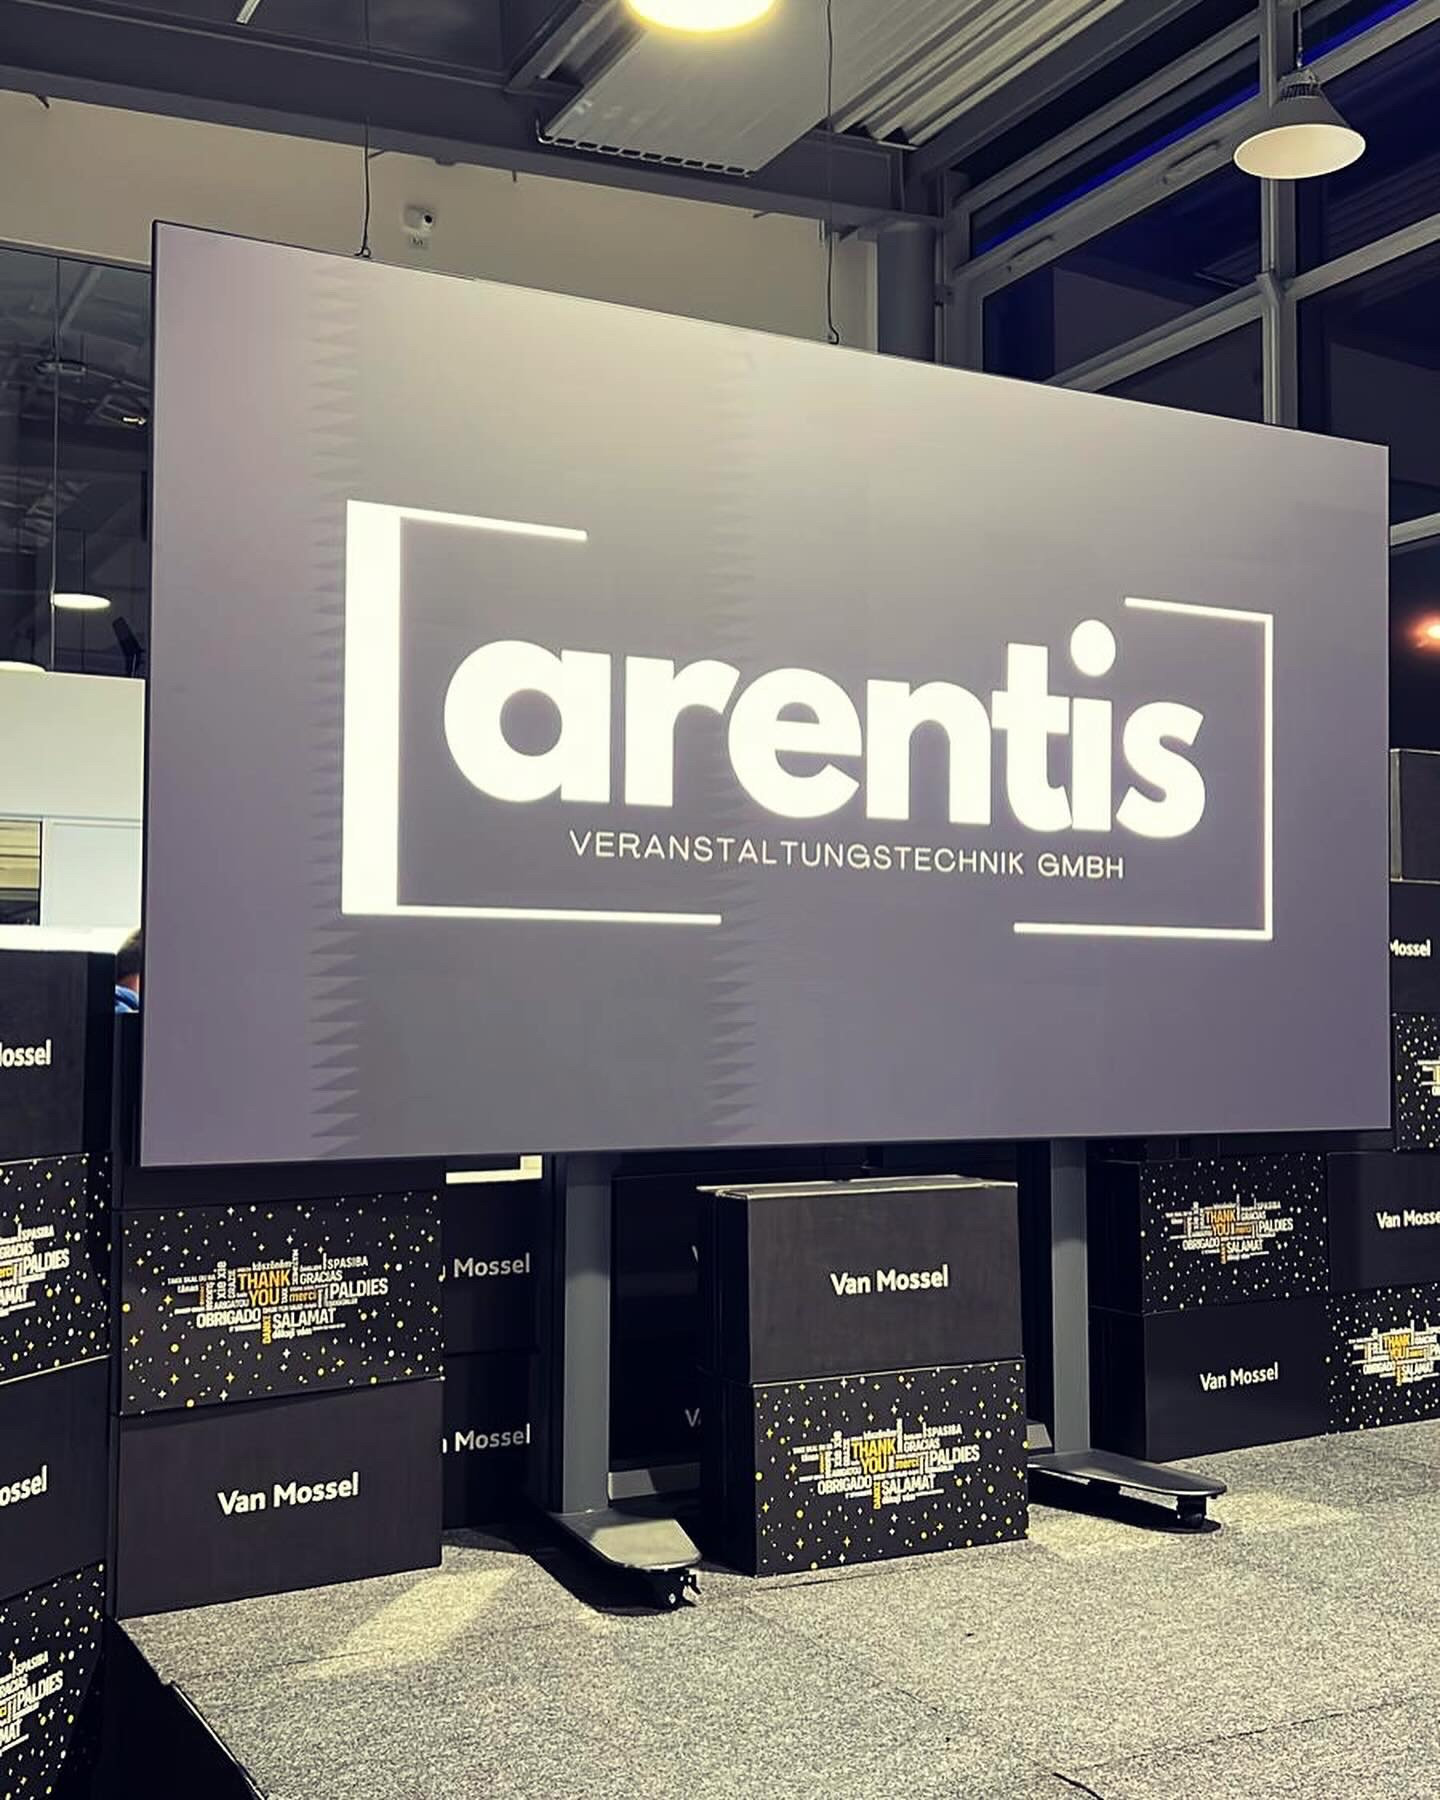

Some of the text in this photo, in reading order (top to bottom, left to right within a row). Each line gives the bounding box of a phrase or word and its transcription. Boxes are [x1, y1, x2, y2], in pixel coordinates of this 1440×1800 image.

[445, 618, 1206, 839] arentis
[570, 830, 1123, 880] VERANSTALTUNGSTECHNIK GMBH
[0, 1039, 51, 1067] ossel
[1376, 1211, 1400, 1229] Van
[24, 1248, 70, 1275] PALDIES
[327, 1256, 369, 1270] SPASIBA
[454, 1252, 530, 1278] Mossel
[237, 1269, 291, 1292] THANK
[300, 1270, 343, 1285] GRACIAS
[330, 1277, 389, 1301] PALDIES
[830, 1263, 949, 1296] Van Mossel
[248, 1287, 280, 1308] YOU
[196, 1307, 262, 1329] OBRIGADO
[272, 1308, 337, 1331] SALAMAT
[1200, 1361, 1278, 1391] Van Mossel
[455, 1423, 531, 1453] Mossel
[850, 1438, 896, 1461] THANK
[860, 1455, 888, 1475] YOU
[929, 1445, 980, 1467] PALDIES
[218, 1471, 360, 1515] Van Mossel
[817, 1475, 872, 1496] OBRIGADO
[882, 1474, 936, 1496] SALAMAT
[18, 1670, 63, 1711] PALDIES
